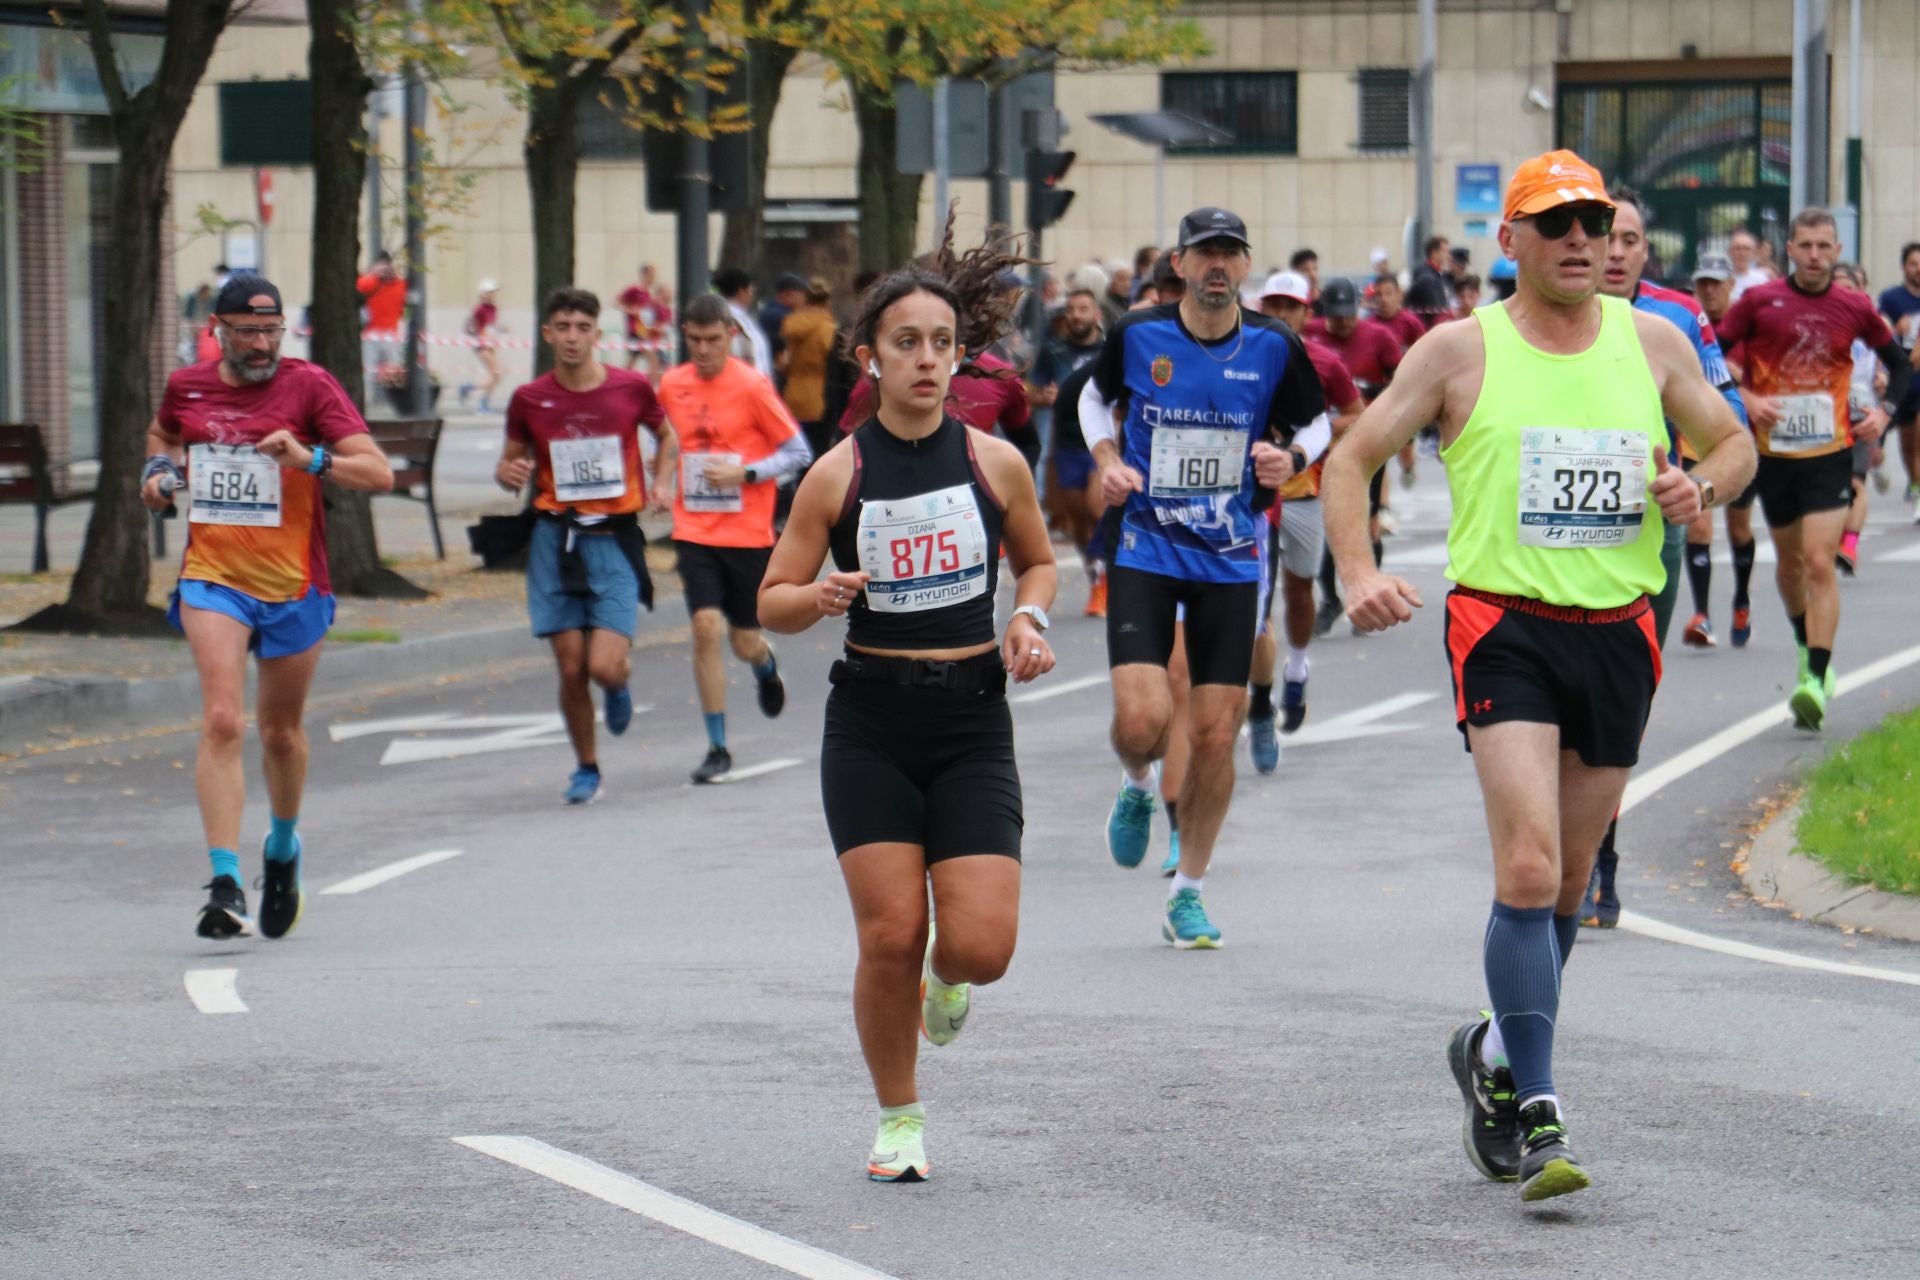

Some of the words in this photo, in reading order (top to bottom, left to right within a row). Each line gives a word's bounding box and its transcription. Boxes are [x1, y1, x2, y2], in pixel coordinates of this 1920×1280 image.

[1786, 414, 1815, 435] 481
[572, 460, 603, 483] 185
[1178, 458, 1219, 486] 160
[1566, 458, 1613, 467] JUANFRAN
[211, 471, 258, 501] 684
[1553, 469, 1622, 513] 323
[907, 522, 937, 535] DIANA
[1570, 528, 1625, 539] HYUNDAI
[890, 529, 960, 579] 875
[914, 582, 970, 602] HYUNDAI
